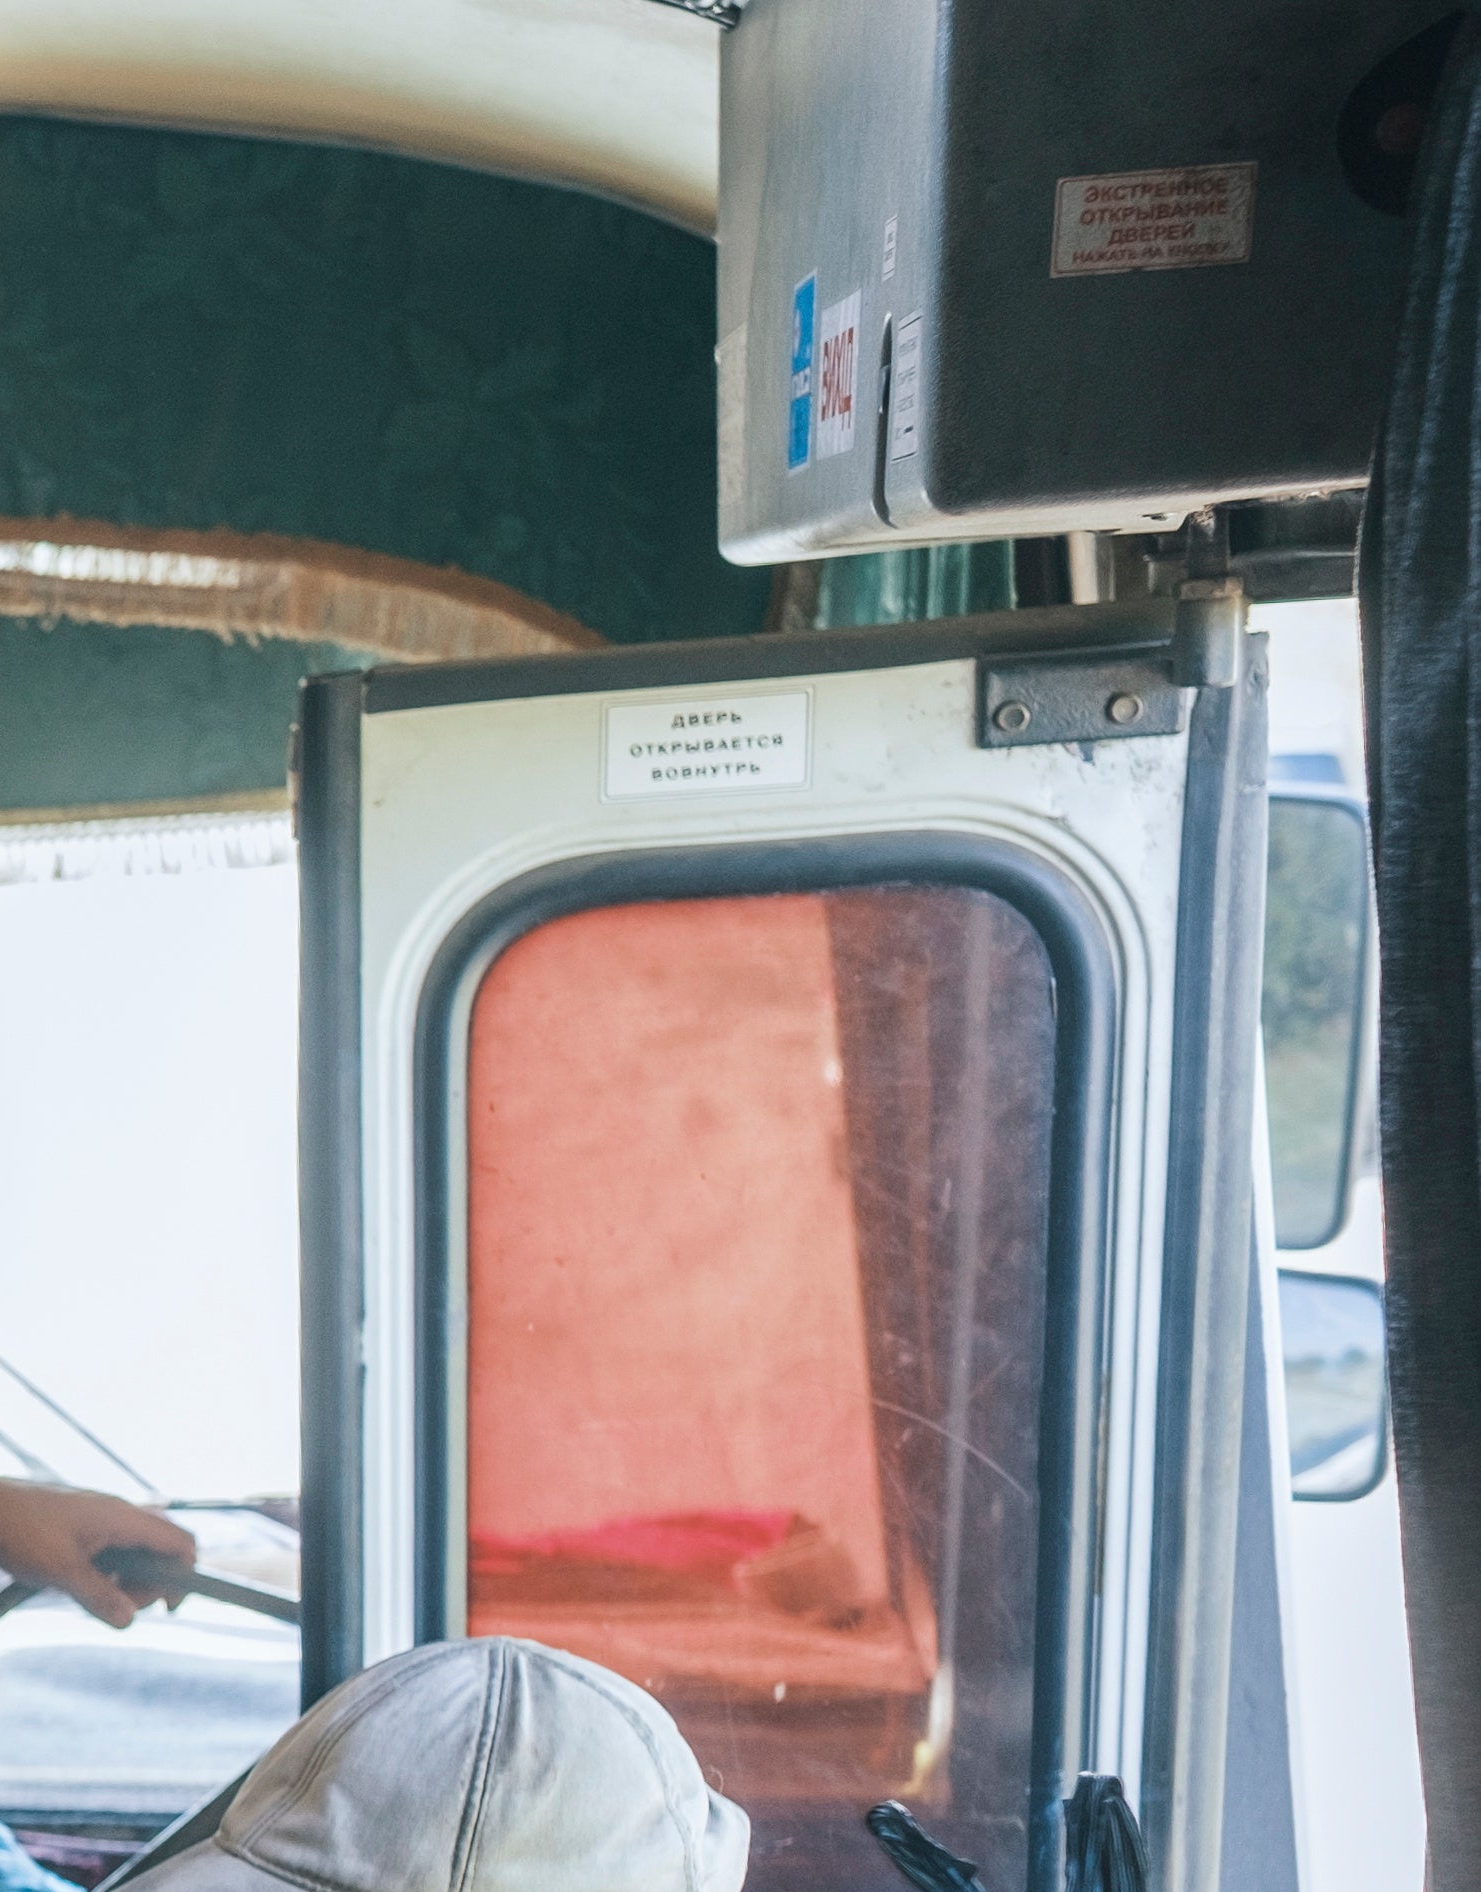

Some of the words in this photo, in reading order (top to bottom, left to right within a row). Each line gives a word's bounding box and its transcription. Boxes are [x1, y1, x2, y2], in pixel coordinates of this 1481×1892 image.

[1083, 176, 1229, 204] ЭКСТРЕННОЕ
[1080, 200, 1228, 226] ОТКРЫВАНИЕ
[1109, 222, 1196, 246] ДВЕРЕЙ
[671, 711, 742, 731] ДВЕРЬ
[630, 734, 784, 758] ОТКРЫВАЕТСЯ
[651, 762, 762, 782] ВОВНУТРЬ
